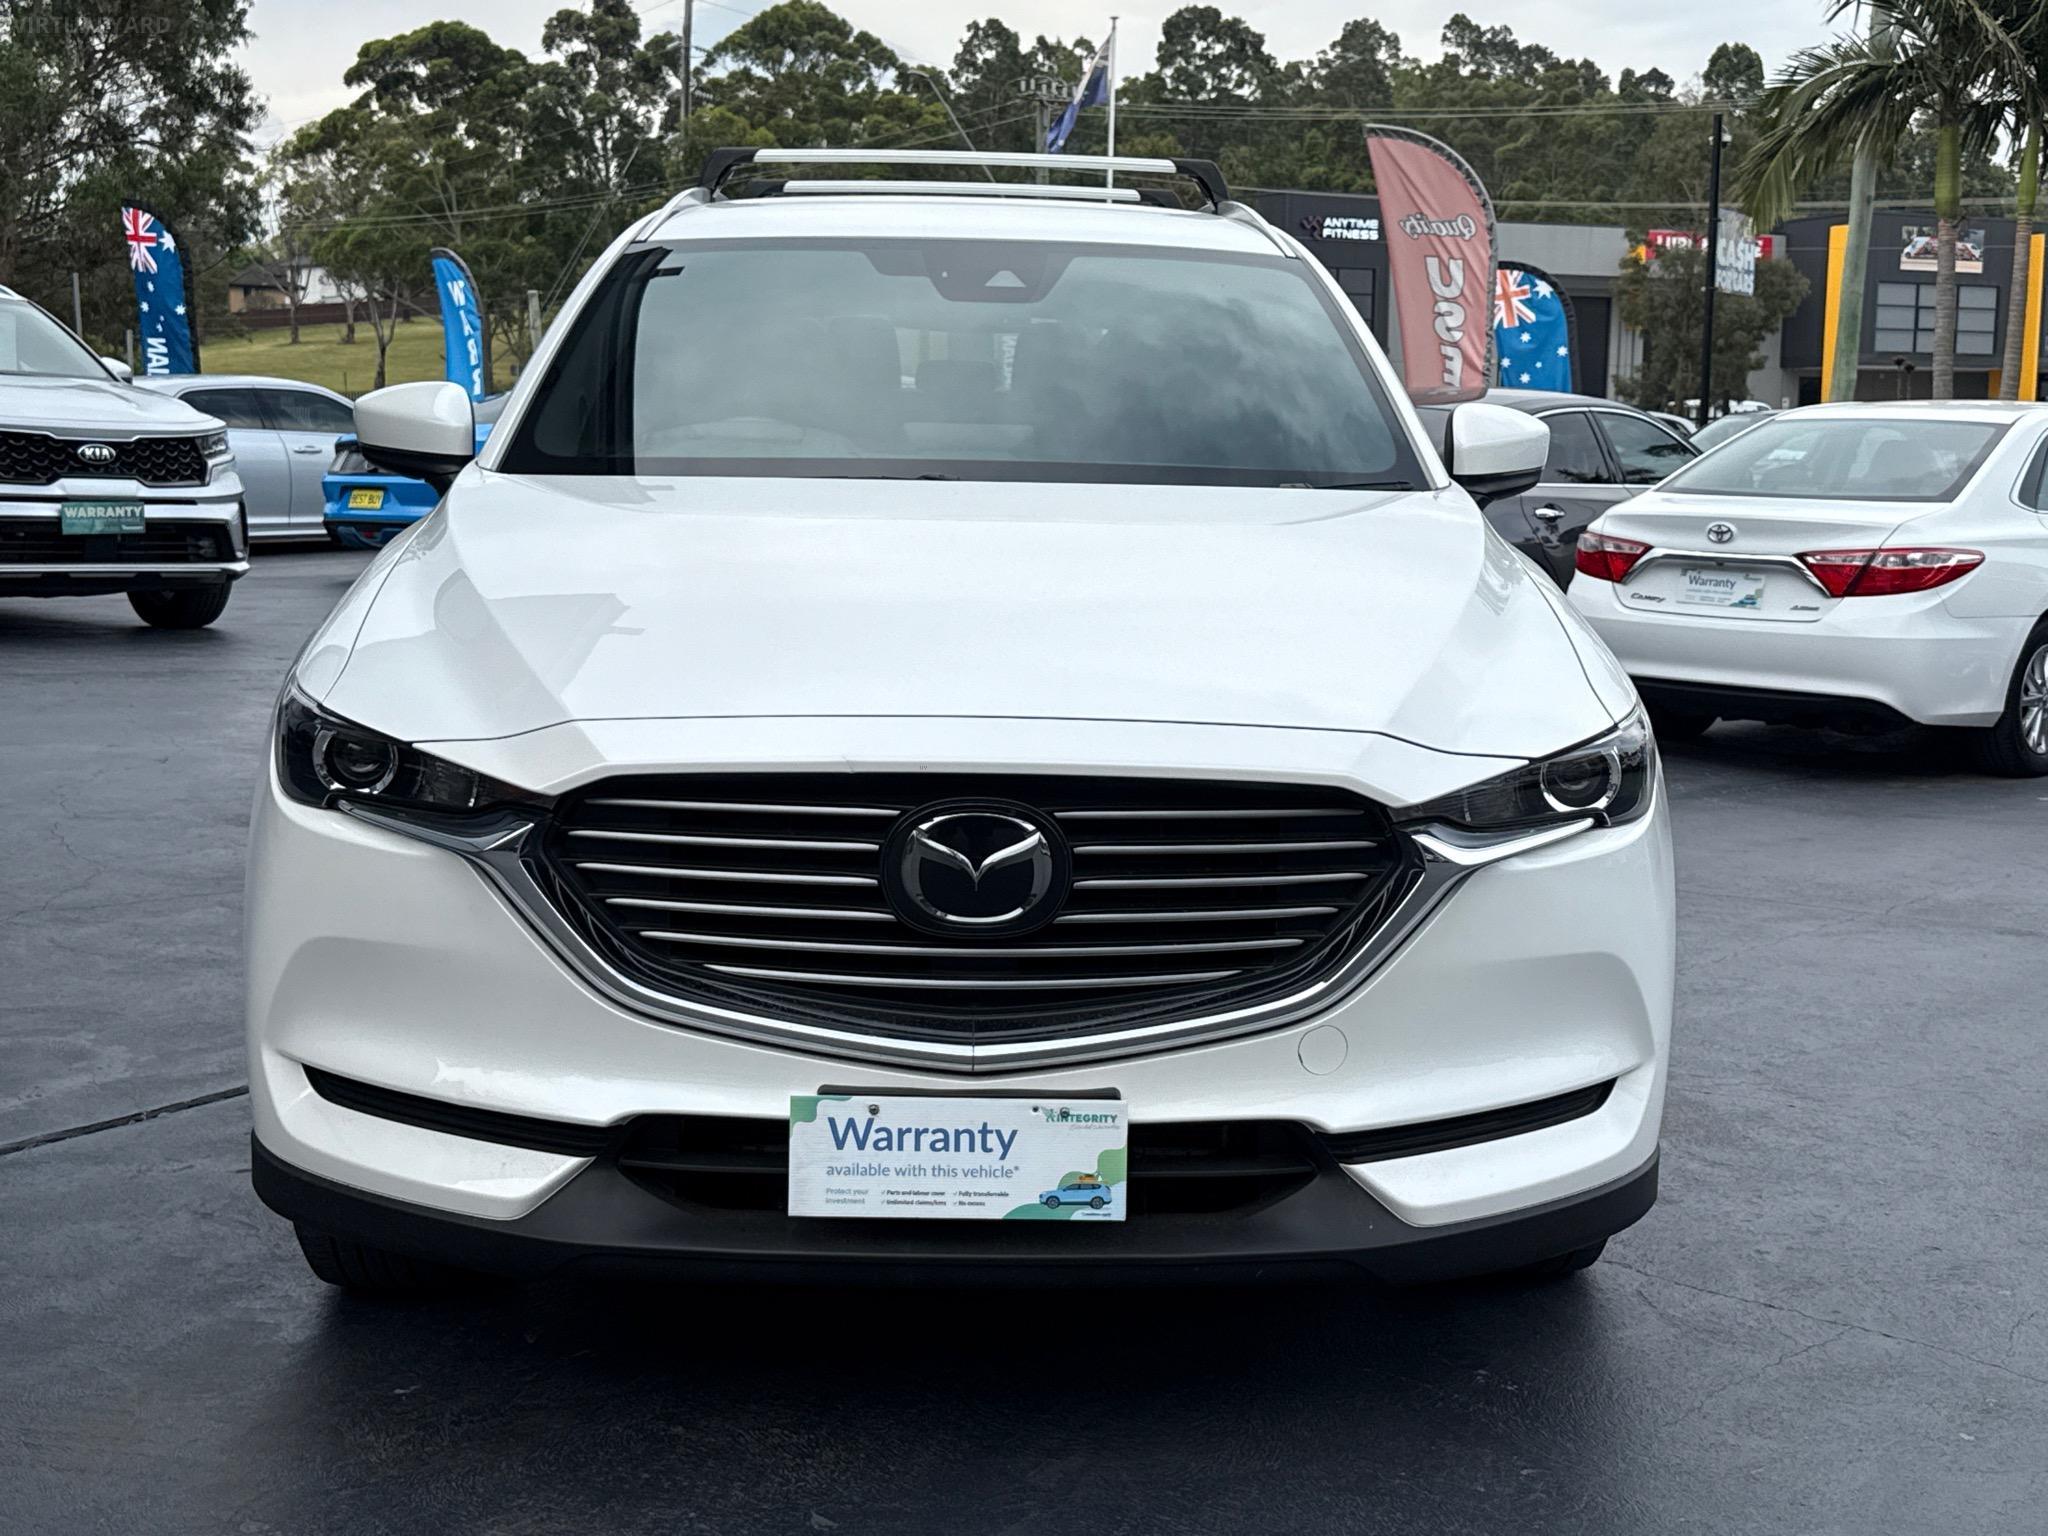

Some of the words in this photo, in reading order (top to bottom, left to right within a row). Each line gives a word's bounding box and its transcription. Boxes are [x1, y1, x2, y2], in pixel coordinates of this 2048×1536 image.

[1323, 217, 1379, 229] ANYTIME
[1322, 228, 1379, 240] FITNESS
[1716, 238, 1754, 272] CASH
[83, 447, 111, 460] KIA
[351, 494, 368, 504] BEST
[63, 506, 143, 518] WARRANTY
[1688, 574, 1737, 590] Warranty
[827, 1116, 1019, 1160] Warranty
[826, 1162, 891, 1177] available
[894, 1163, 927, 1177] with
[931, 1164, 958, 1178] this
[825, 1187, 851, 1196] Protect
[853, 1189, 869, 1197] your
